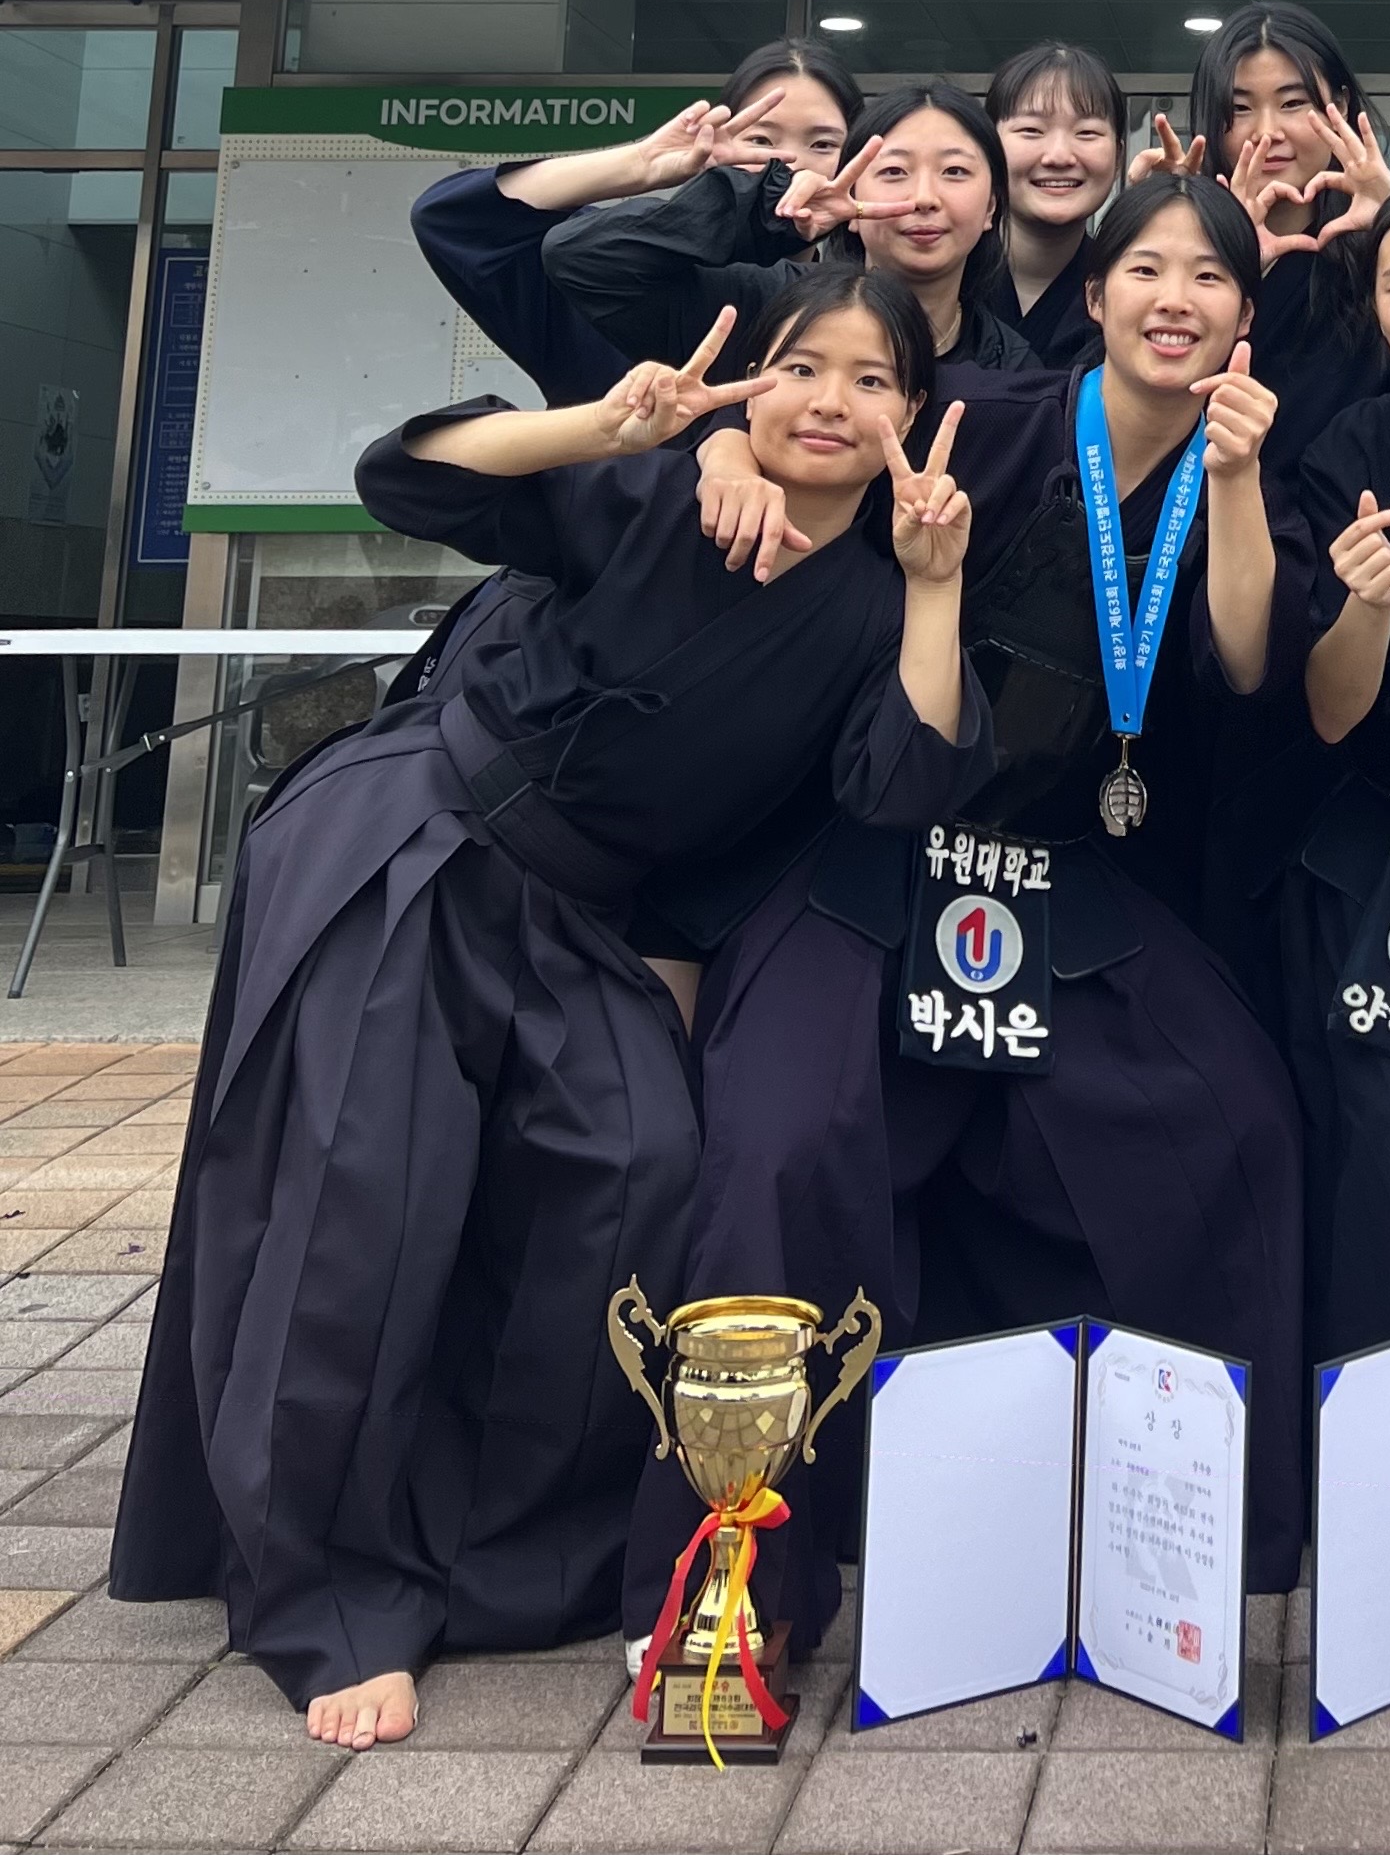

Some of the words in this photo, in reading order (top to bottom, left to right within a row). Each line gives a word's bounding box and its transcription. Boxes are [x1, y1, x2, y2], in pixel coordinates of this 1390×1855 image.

[380, 97, 635, 126] INFORMATION
[1086, 443, 1119, 582] 전국검도단별선수권대회
[1105, 586, 1124, 631] 제63회
[1144, 585, 1166, 628] 제63회
[1113, 632, 1127, 671] 회장기
[1134, 630, 1155, 670] 회장기
[926, 825, 1051, 897] 유원대학교
[908, 989, 1049, 1058] 박시은
[1145, 1410, 1156, 1432] 상
[1170, 1418, 1182, 1440] 장
